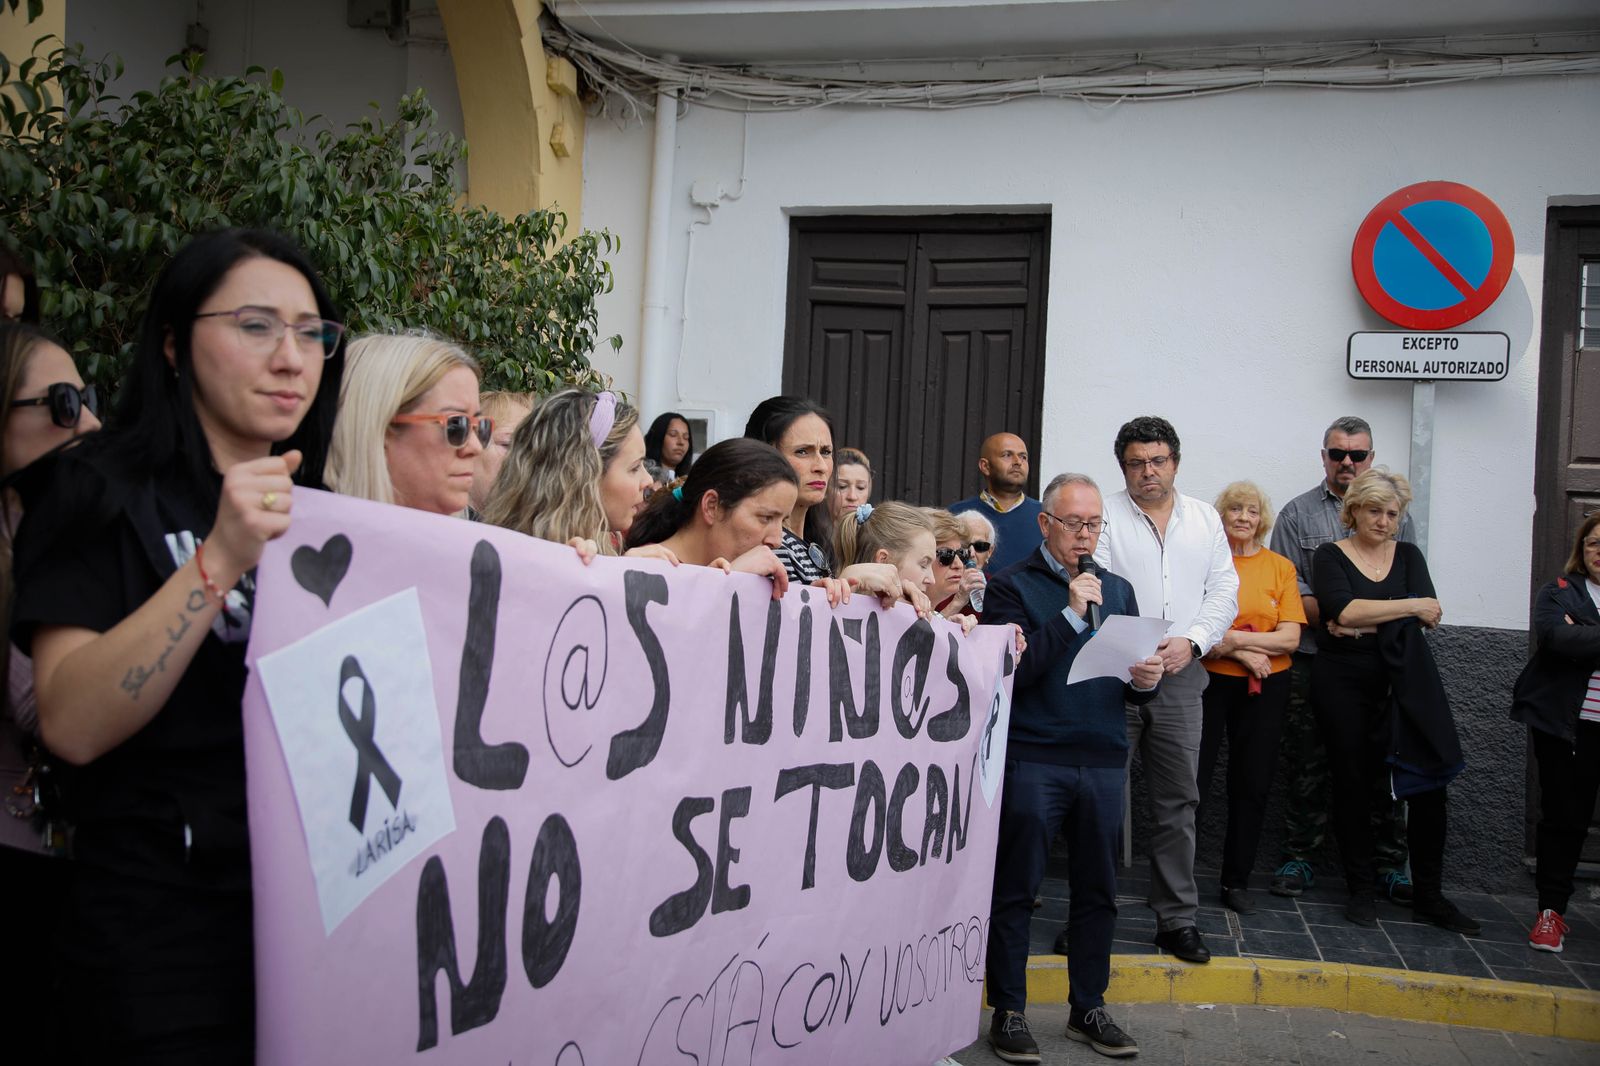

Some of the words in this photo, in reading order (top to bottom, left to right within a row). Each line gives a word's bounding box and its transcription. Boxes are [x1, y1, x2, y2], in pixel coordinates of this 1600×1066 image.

[1355, 360, 1419, 373] PERSONAL
[1423, 361, 1504, 375] AUTORIZADO
[1402, 337, 1459, 350] EXCEPTO
[453, 538, 670, 790] L@S
[416, 813, 582, 1052] NO
[649, 786, 752, 937] SE
[774, 752, 977, 890] TOCAN
[772, 948, 871, 1048] CON
